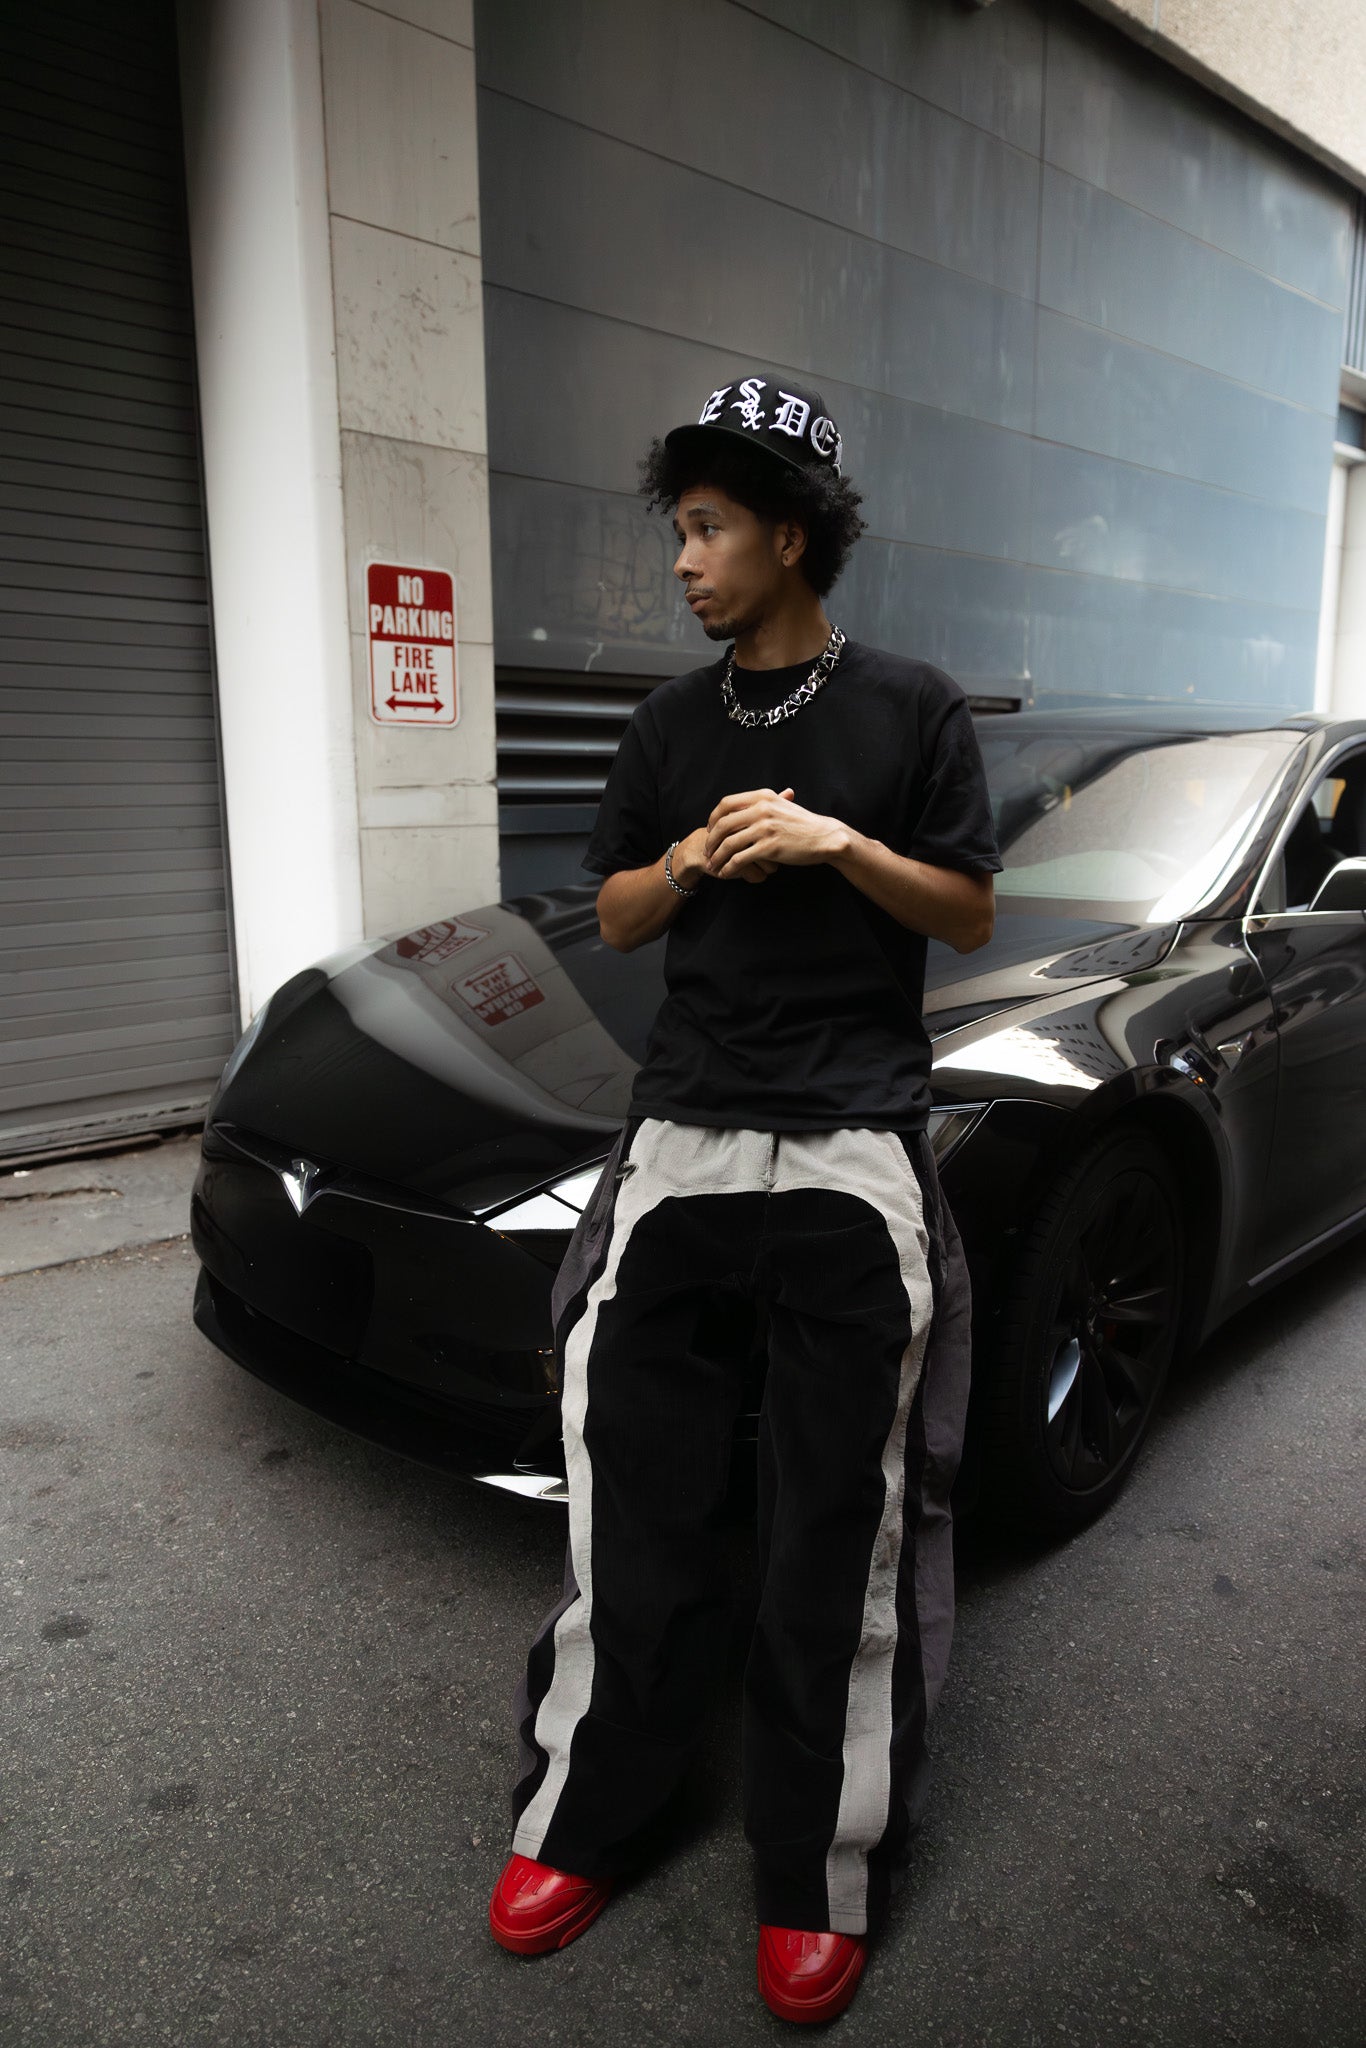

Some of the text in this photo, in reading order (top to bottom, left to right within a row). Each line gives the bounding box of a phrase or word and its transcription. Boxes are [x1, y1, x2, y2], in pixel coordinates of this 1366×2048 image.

[397, 575, 424, 606] NO
[370, 603, 453, 640] PARKING
[394, 646, 434, 669] FIRE
[391, 671, 438, 694] LANE
